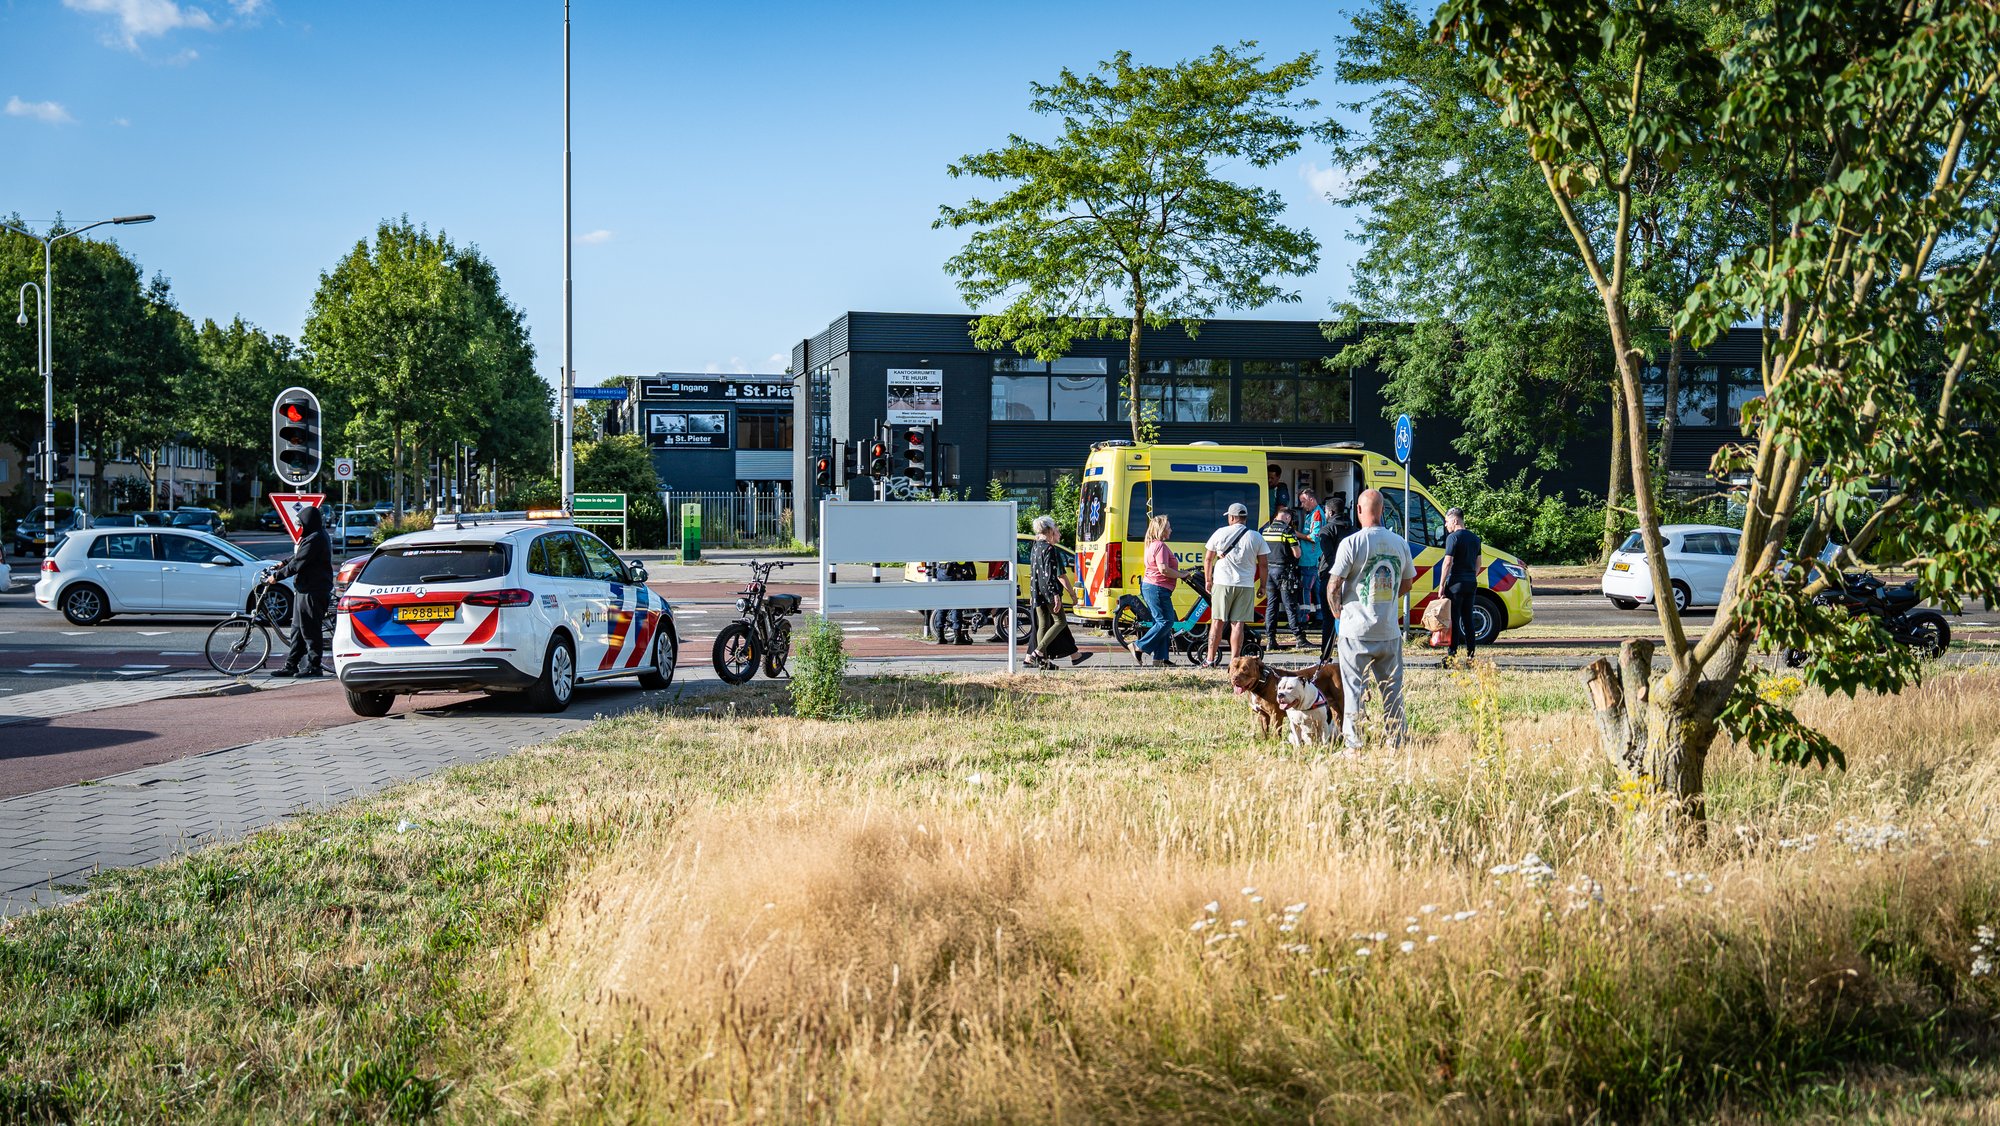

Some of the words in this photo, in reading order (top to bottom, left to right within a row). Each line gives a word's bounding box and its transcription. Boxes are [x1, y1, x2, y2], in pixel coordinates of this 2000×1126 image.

[681, 384, 708, 393] Ingang
[743, 384, 765, 397] St.
[369, 586, 412, 595] POLITIE
[401, 607, 450, 618] P-988-LR
[1195, 602, 1207, 617] dott
